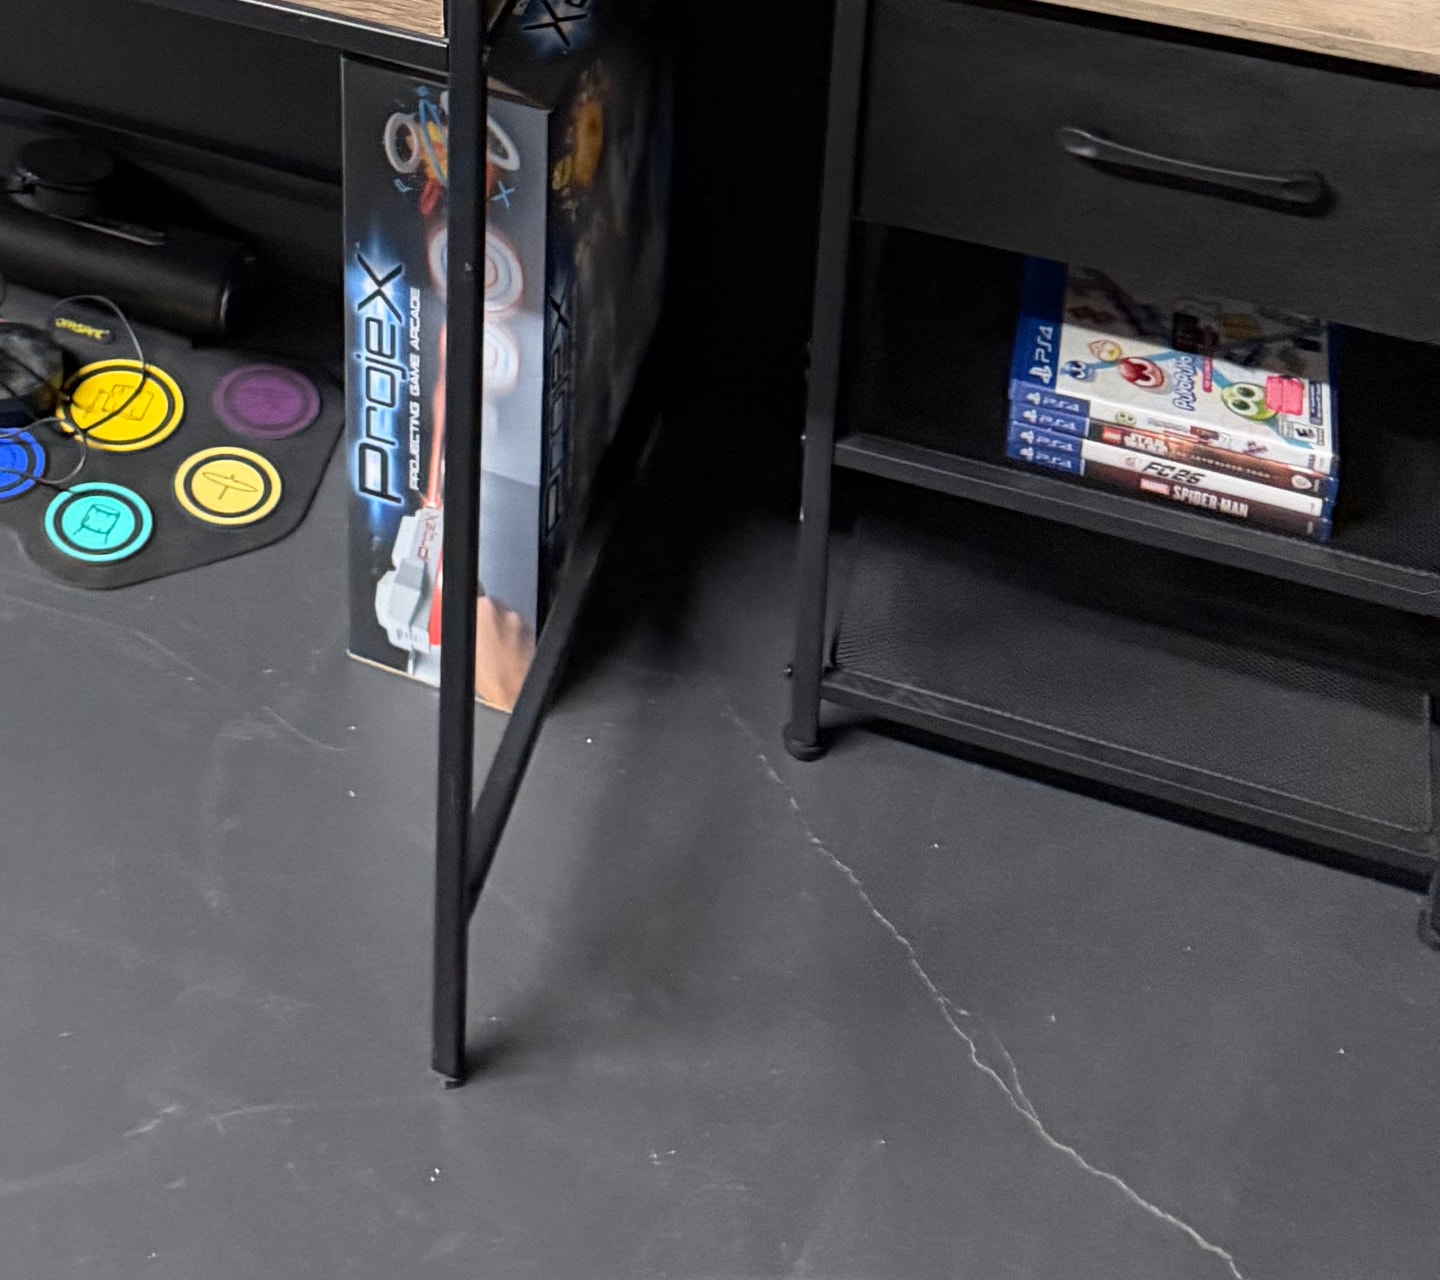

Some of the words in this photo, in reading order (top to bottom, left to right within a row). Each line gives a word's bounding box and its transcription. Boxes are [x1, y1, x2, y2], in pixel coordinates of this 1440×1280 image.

[410, 287, 421, 350] ARCADE
[1035, 325, 1054, 364] PS4
[410, 351, 421, 399] GAME
[1042, 396, 1079, 413] PS4
[409, 400, 421, 491] PROJECTING
[1142, 461, 1175, 478] FC
[1172, 469, 1206, 485] 26
[1172, 486, 1249, 518] SPIDER-MAN
